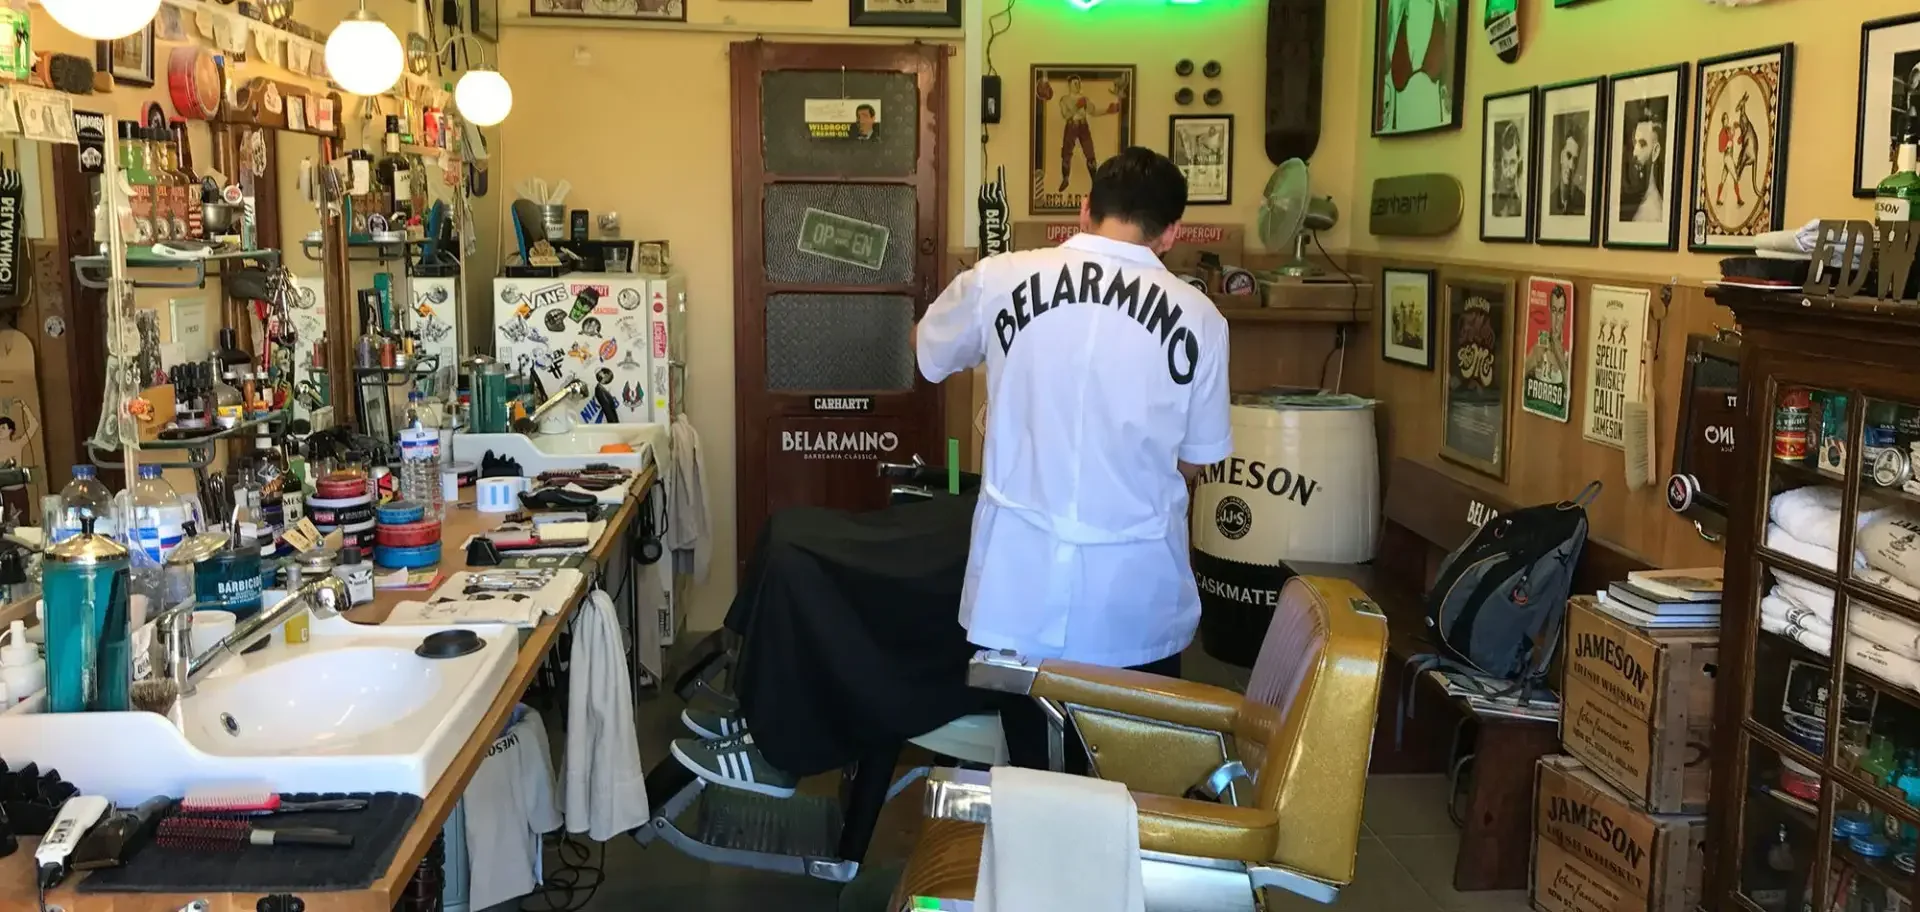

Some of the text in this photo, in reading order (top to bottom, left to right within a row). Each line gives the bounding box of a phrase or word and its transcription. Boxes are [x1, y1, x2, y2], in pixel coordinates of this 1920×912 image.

[808, 123, 851, 131] WILDROOT
[519, 283, 569, 311] VANS
[994, 261, 1199, 385] BELARMINO
[1596, 345, 1628, 371] SPELL IT
[1528, 379, 1563, 406] PRORASO
[1595, 367, 1626, 393] WHISKEY
[814, 398, 870, 410] CARHARTT
[1593, 388, 1625, 420] CALL IT
[781, 431, 899, 452] BELARMINO
[1592, 416, 1624, 441] JAMESON
[1198, 457, 1318, 507] AMESON
[1575, 631, 1649, 694] JAMESON
[1574, 661, 1645, 712] IRISH WHISKEY
[1548, 796, 1646, 870] JAMESON
[1583, 845, 1643, 889] WHISKEY
